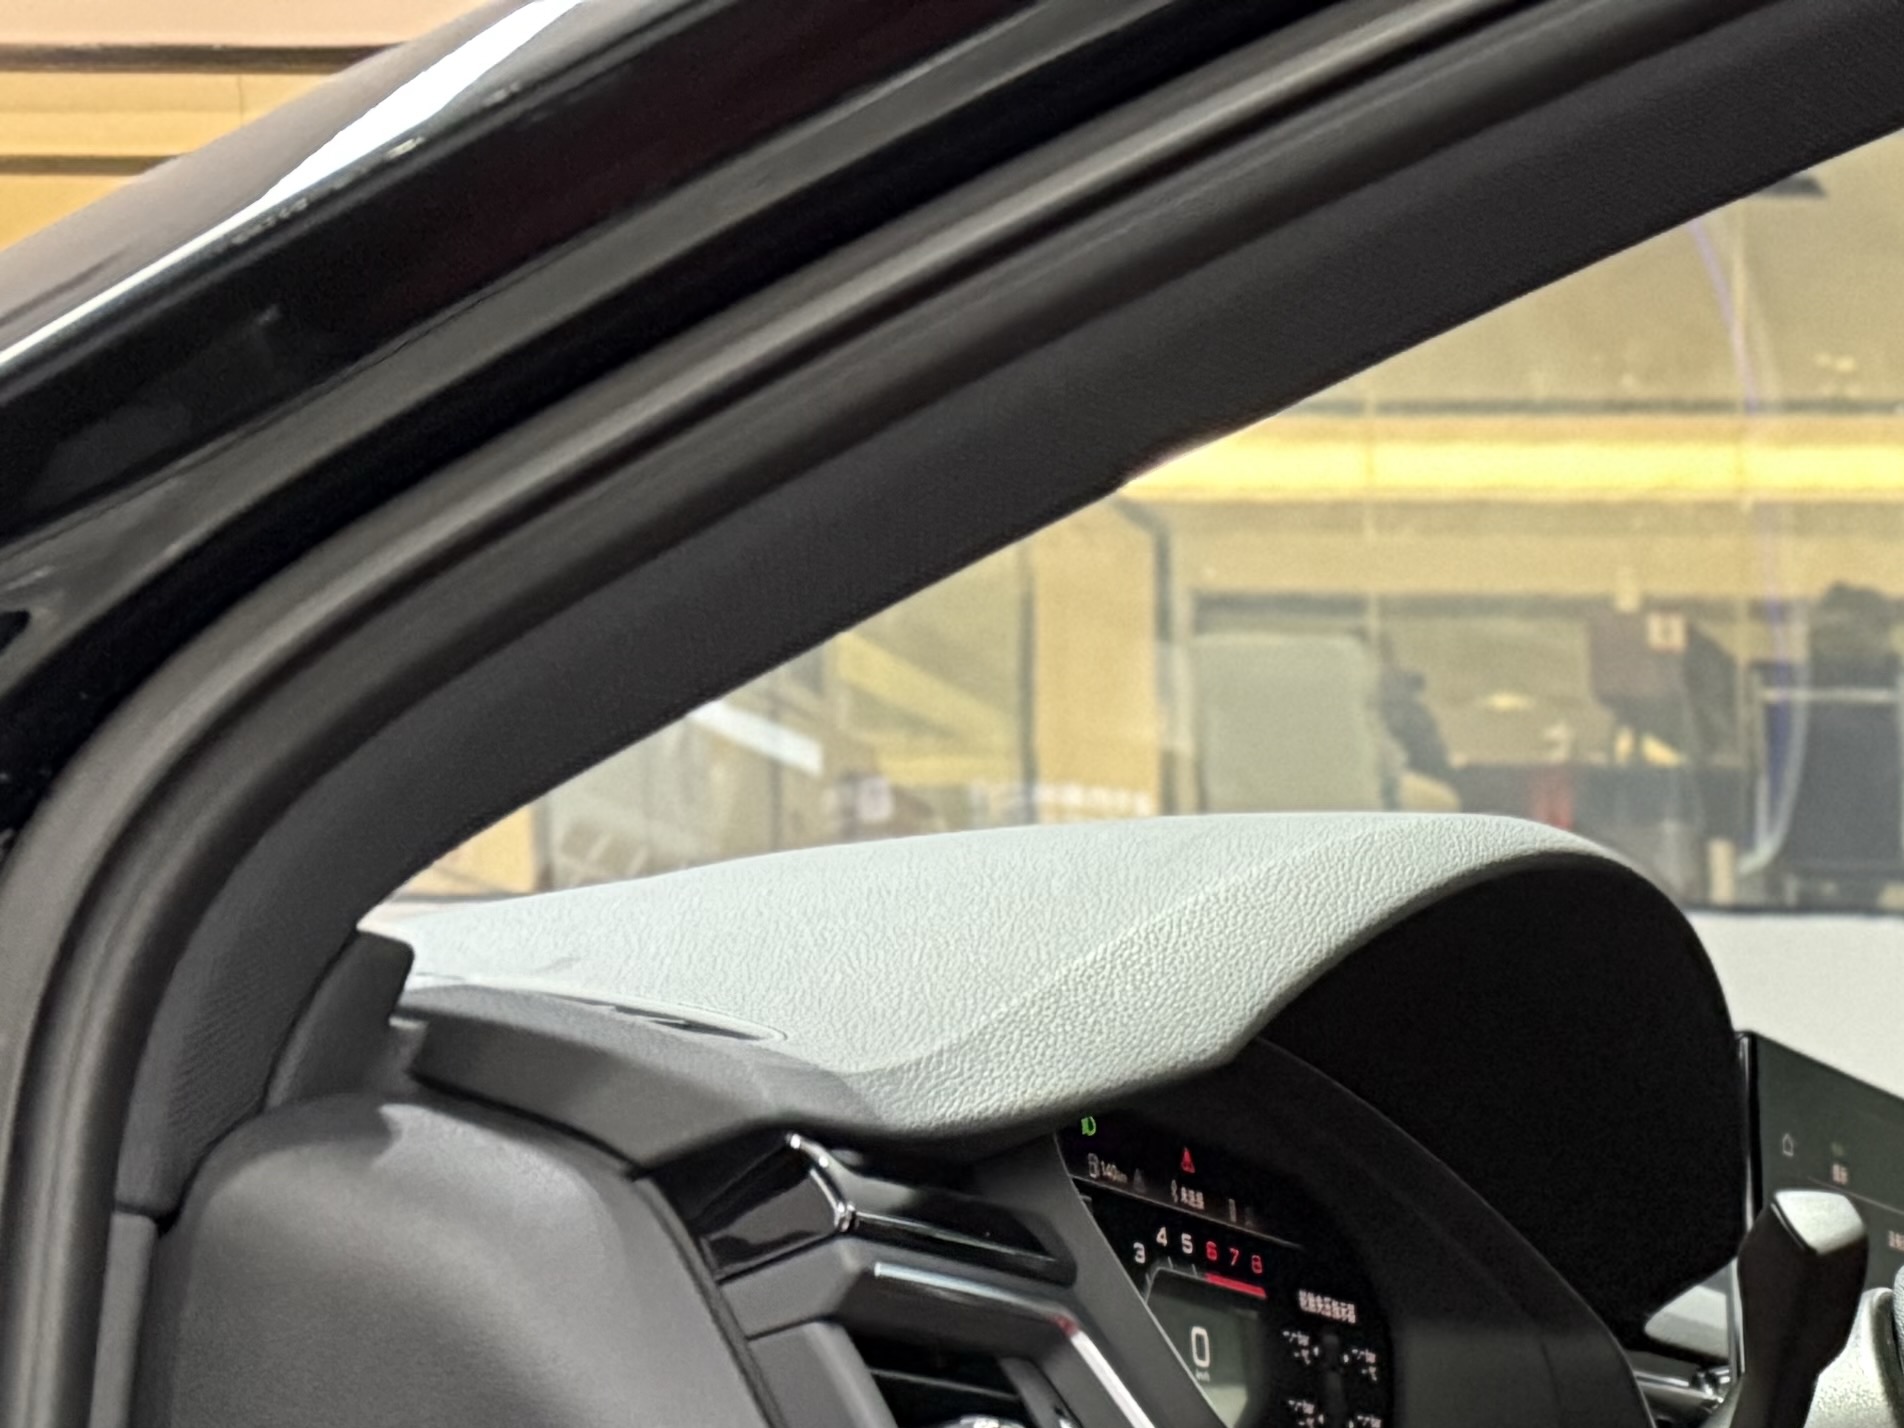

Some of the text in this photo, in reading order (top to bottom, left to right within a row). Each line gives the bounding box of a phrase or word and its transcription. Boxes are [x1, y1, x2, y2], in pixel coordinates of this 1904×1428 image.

[1133, 1226, 1263, 1274] 3 4 5 6 7 8
[1191, 1326, 1210, 1368] 0
